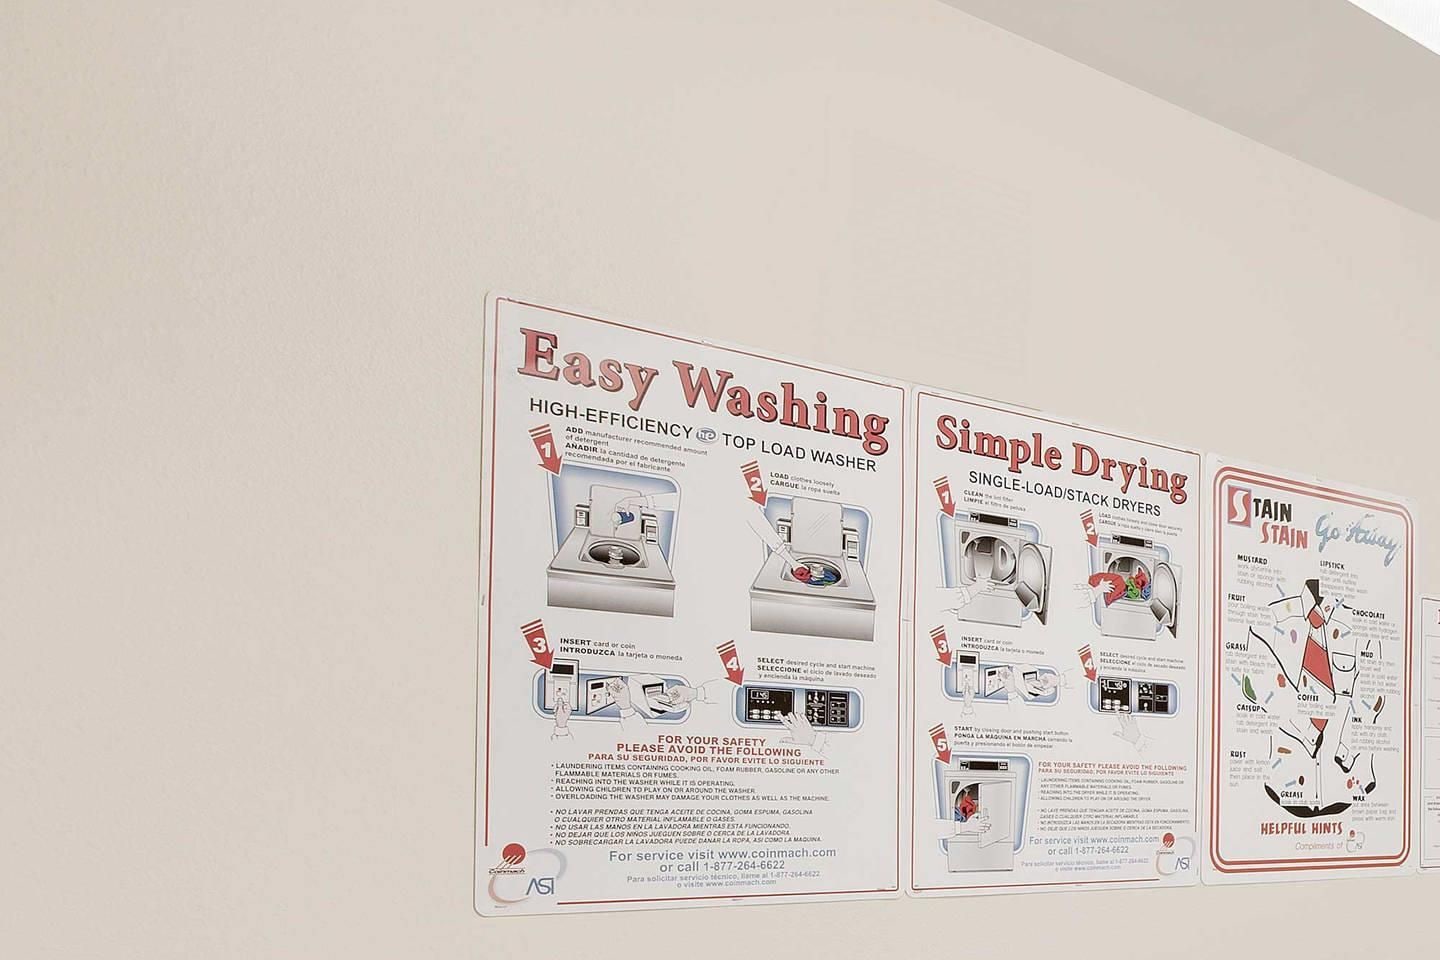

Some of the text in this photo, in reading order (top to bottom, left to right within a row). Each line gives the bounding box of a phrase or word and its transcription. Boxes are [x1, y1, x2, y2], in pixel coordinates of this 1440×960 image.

[517, 327, 889, 456] Easy Washing
[530, 398, 877, 472] HIGH-EFFICIENCY TOP LOAD WASHER
[566, 427, 708, 455] ADD manufacturer recommended amount
[574, 436, 609, 446] detergent
[565, 452, 614, 464] recomendada
[636, 461, 670, 472] fabricante
[608, 451, 638, 459] cantidad
[649, 456, 686, 467] detergente
[936, 415, 1188, 504] Simple Drying
[770, 472, 789, 480] LOAD
[813, 478, 835, 489] loosely
[964, 490, 984, 498] CLEAN
[969, 471, 1161, 517] SINGLE-LOAD/STACK DRYERS
[1229, 488, 1292, 524] STAIN
[1260, 522, 1308, 549] STAIN
[1237, 554, 1268, 565] MUSTARD
[1320, 560, 1345, 570] LIPSTICK
[1228, 593, 1246, 602] FRUIT
[1352, 608, 1385, 620] CHOCOLATE
[560, 638, 591, 646] INSERT
[1225, 641, 1246, 651] GRASS
[560, 647, 615, 656] INTRODUZCA
[960, 643, 999, 652] INTRODUZCA
[1360, 651, 1374, 659] MUD
[757, 657, 784, 665] SELECT
[757, 665, 802, 674] SELECCIONE
[1297, 693, 1319, 702] COFFEE
[1236, 704, 1261, 713] CATSUP
[1352, 716, 1362, 724] INK
[658, 735, 766, 746] FOR YOUR SAFETY
[616, 744, 801, 756] PLEASE AVOID THE FOLLOWING
[1230, 750, 1246, 758] RUST
[632, 755, 688, 764] SEGURIDAD,
[782, 758, 824, 766] SIGUIENTE
[1280, 790, 1303, 799] GREASE
[1260, 821, 1343, 835] HELPFUL HINTS
[1029, 835, 1160, 845] For service visit www.coinmach.com
[609, 848, 836, 861] For service visit www.coinmach.com
[1058, 846, 1072, 855] call
[1075, 846, 1128, 855] 1-877-264-6622
[677, 862, 699, 872] call
[703, 861, 785, 871] 1-877-264-6622
